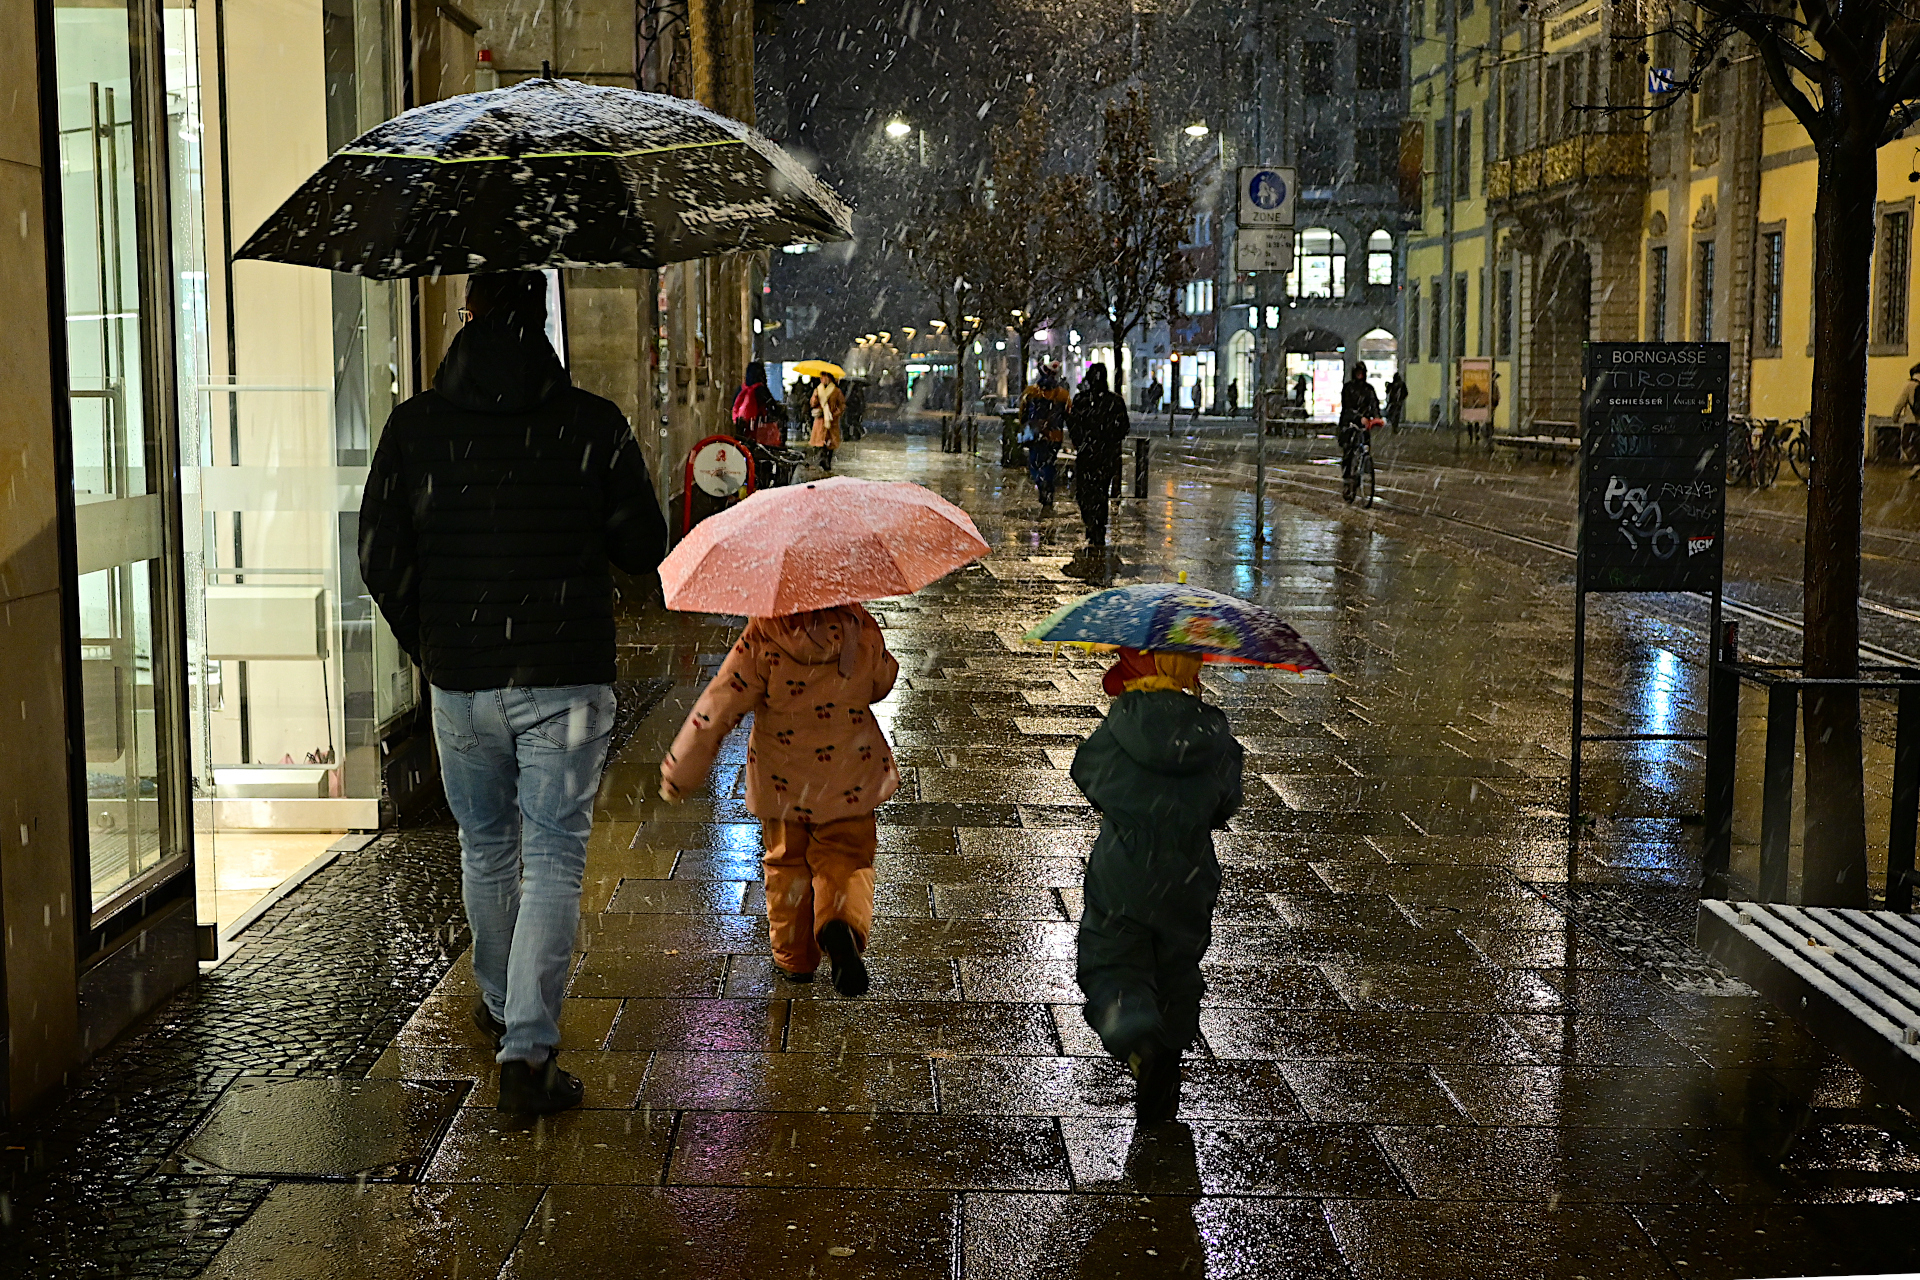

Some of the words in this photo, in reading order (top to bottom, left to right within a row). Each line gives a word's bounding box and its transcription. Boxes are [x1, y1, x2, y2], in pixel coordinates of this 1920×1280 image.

[1252, 212, 1281, 222] ZONE
[1612, 350, 1707, 364] BORNGASSE
[1609, 398, 1663, 406] SCHIESSER
